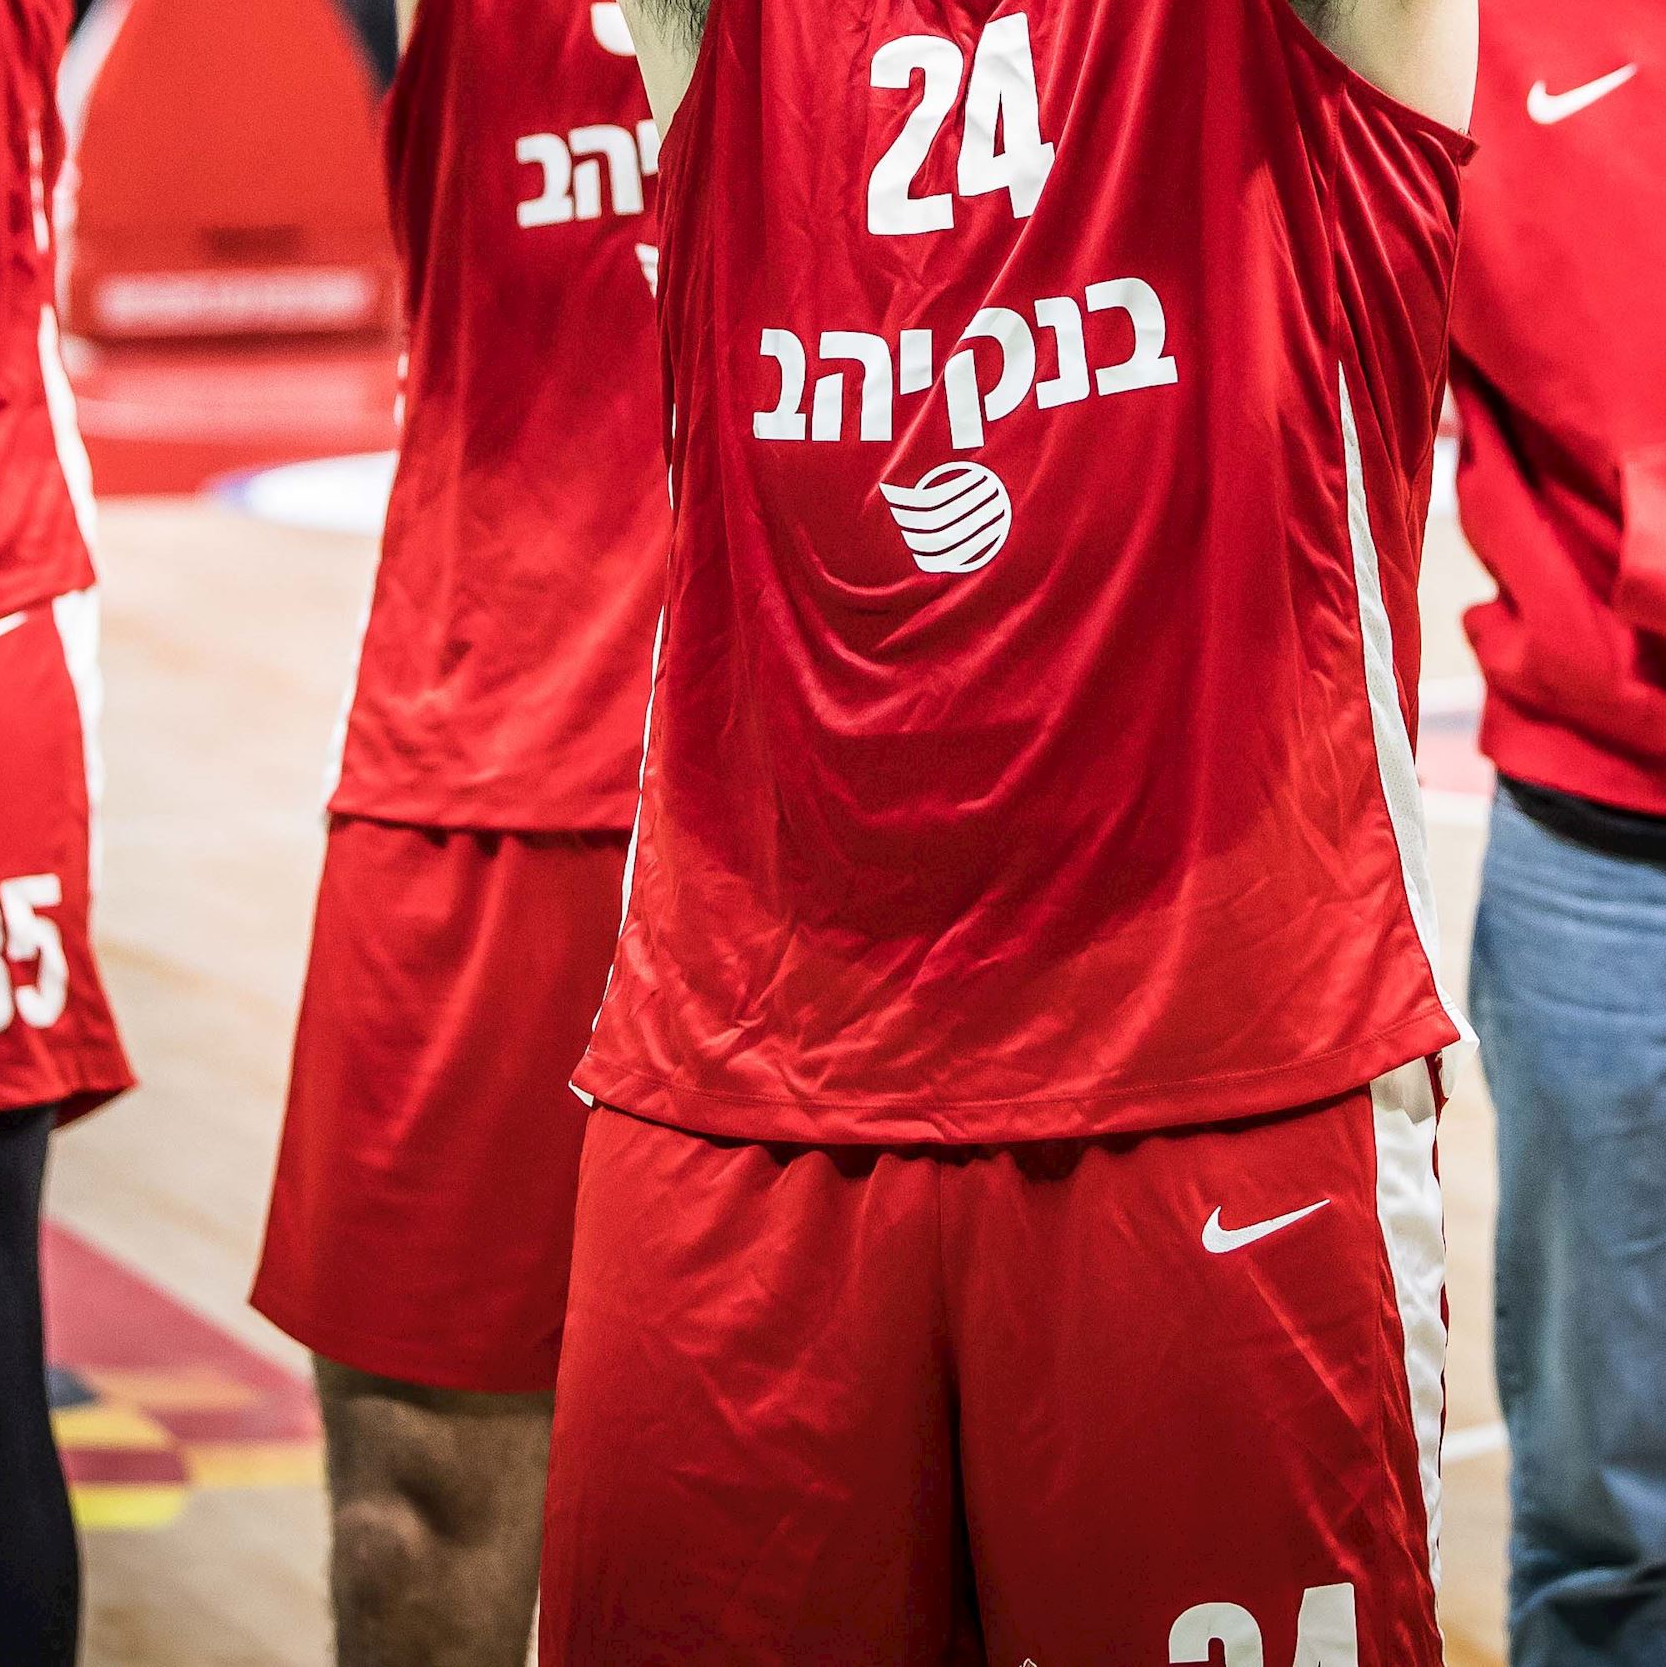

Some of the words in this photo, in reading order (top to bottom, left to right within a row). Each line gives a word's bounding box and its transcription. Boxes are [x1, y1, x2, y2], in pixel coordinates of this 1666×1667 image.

[866, 11, 1056, 236] 24
[752, 327, 934, 442] יהב
[944, 276, 1179, 450] בנק
